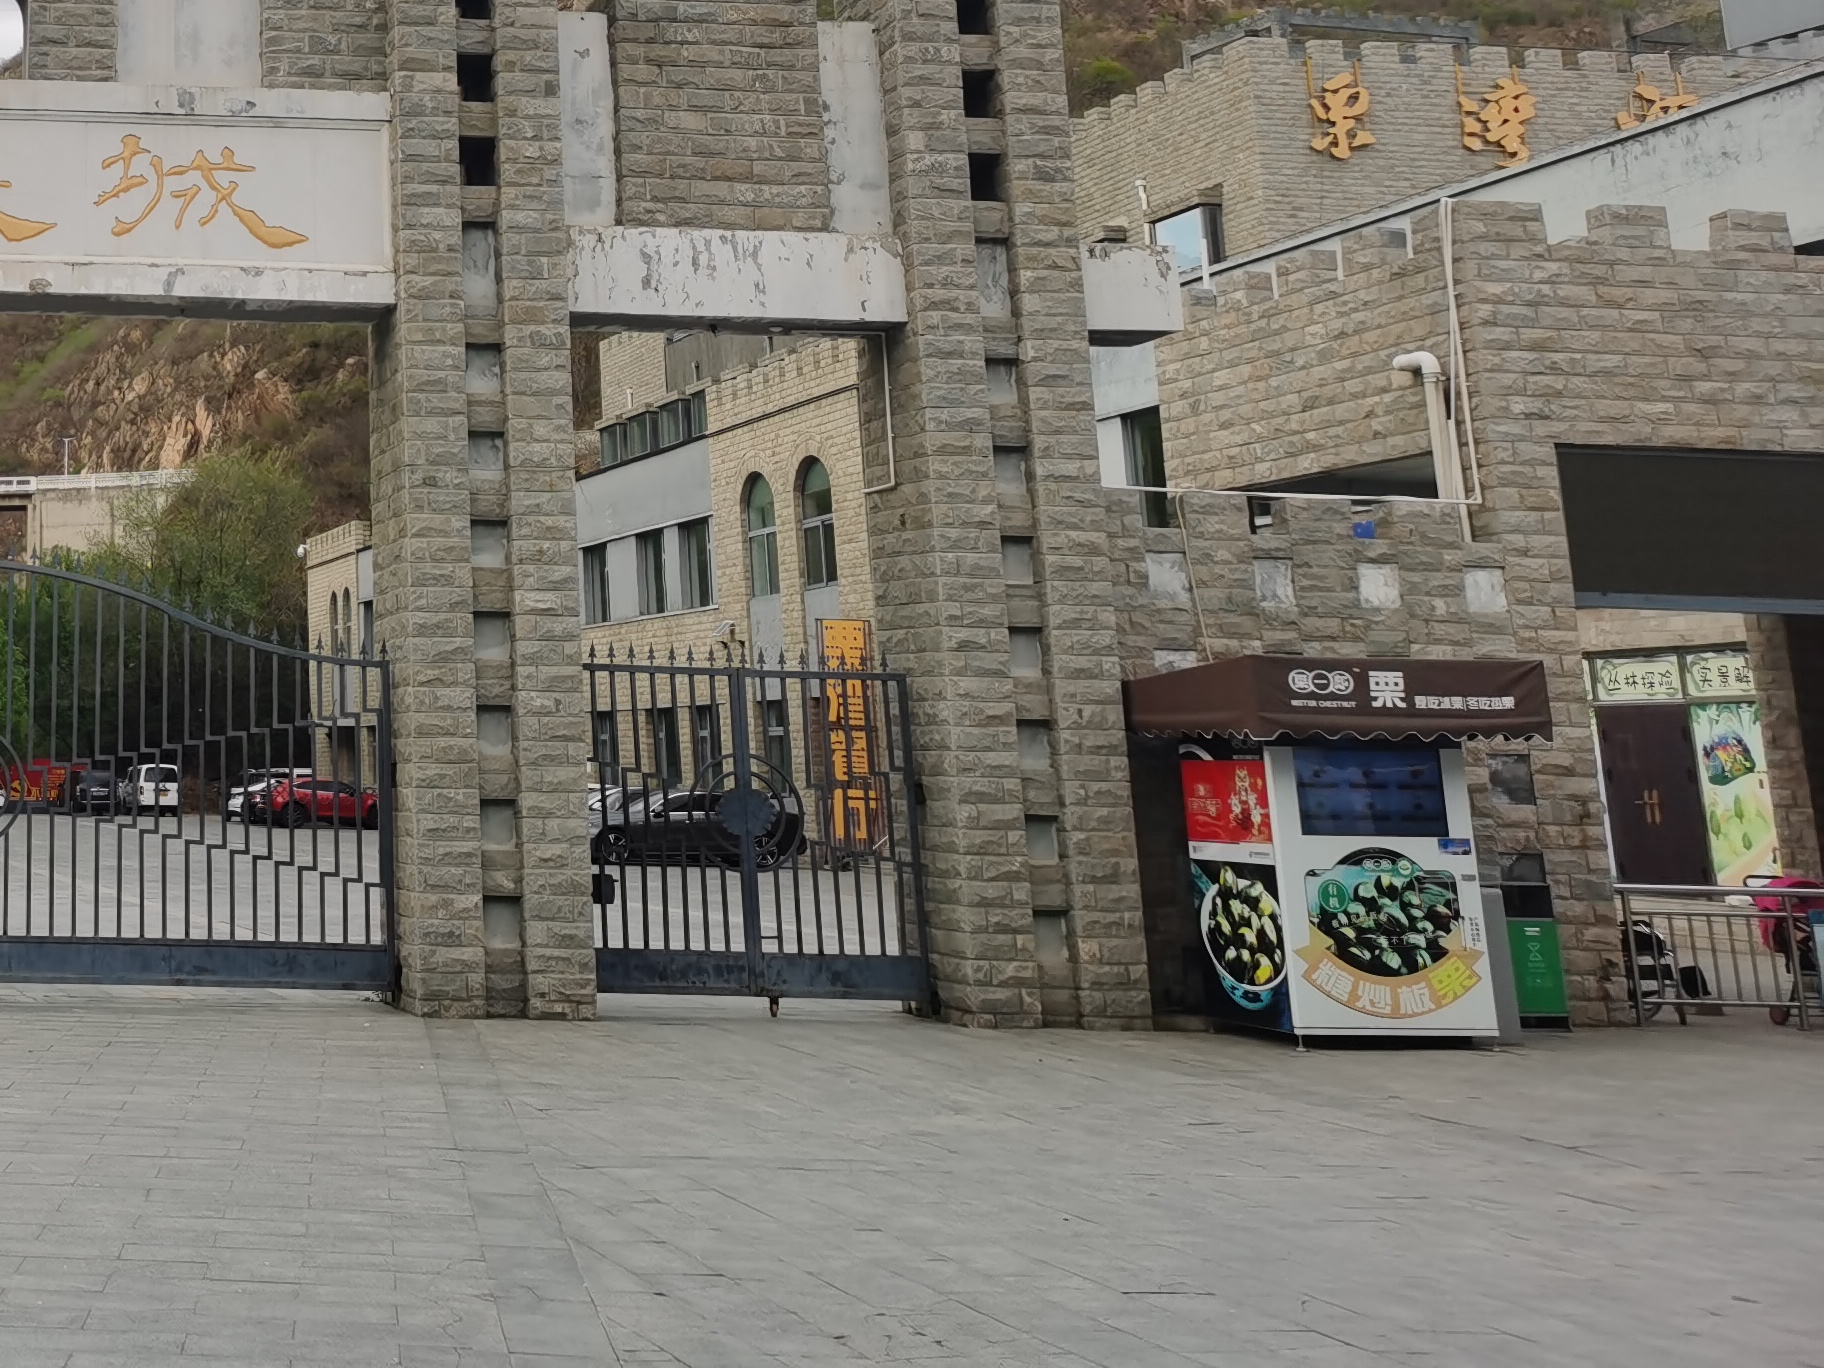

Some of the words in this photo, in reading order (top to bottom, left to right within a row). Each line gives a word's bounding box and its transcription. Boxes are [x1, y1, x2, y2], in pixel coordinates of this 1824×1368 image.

[1368, 671, 1406, 708] 栗
[1311, 957, 1480, 1015] 糖炒板栗
